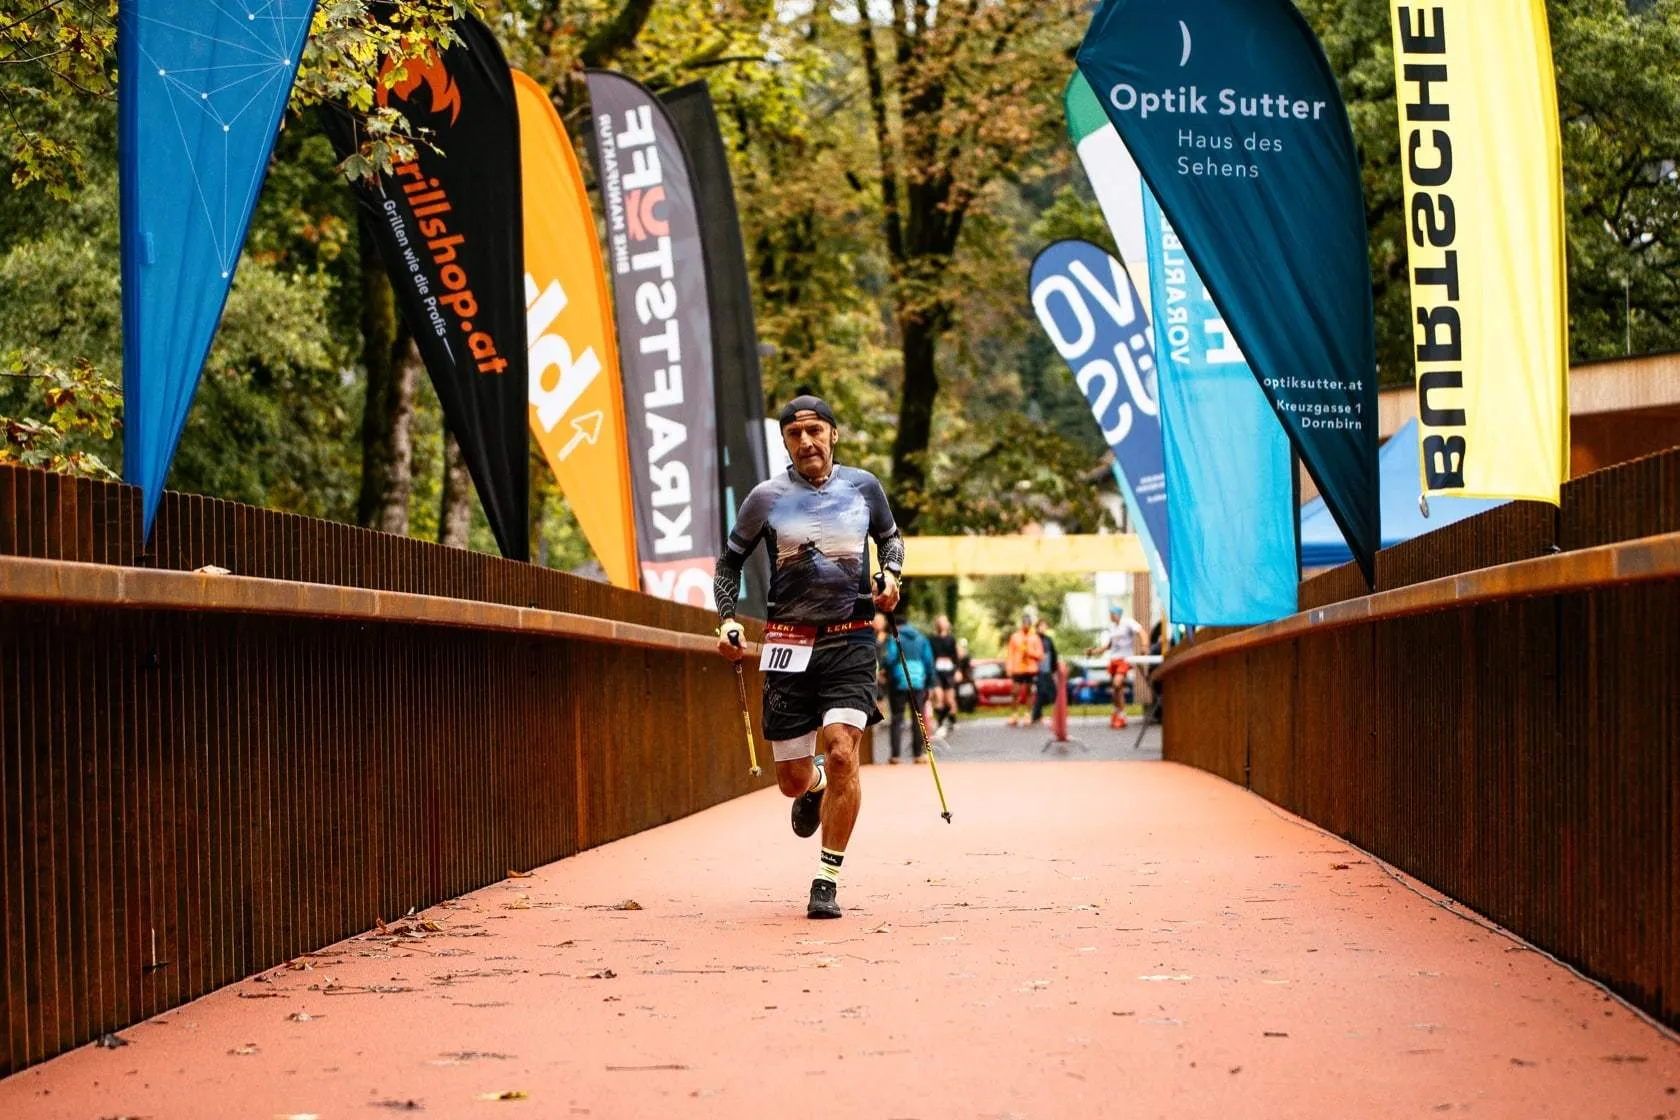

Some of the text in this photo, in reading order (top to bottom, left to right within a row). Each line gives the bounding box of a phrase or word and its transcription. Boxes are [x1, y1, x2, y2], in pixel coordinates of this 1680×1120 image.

[1110, 83, 1326, 120] Optik Sutter
[1177, 128, 1283, 152] Haus des
[1177, 156, 1260, 178] Sehens
[383, 200, 447, 337] Grillen wie die Profis
[390, 150, 508, 374] rillshop.at
[1263, 376, 1363, 391] optiksutter.at
[1276, 399, 1362, 416] Kreuzgasse 1
[1301, 417, 1362, 430] Dornbirn
[771, 623, 795, 632] LEKI
[827, 621, 852, 633] LEKI
[768, 647, 793, 669] 110
